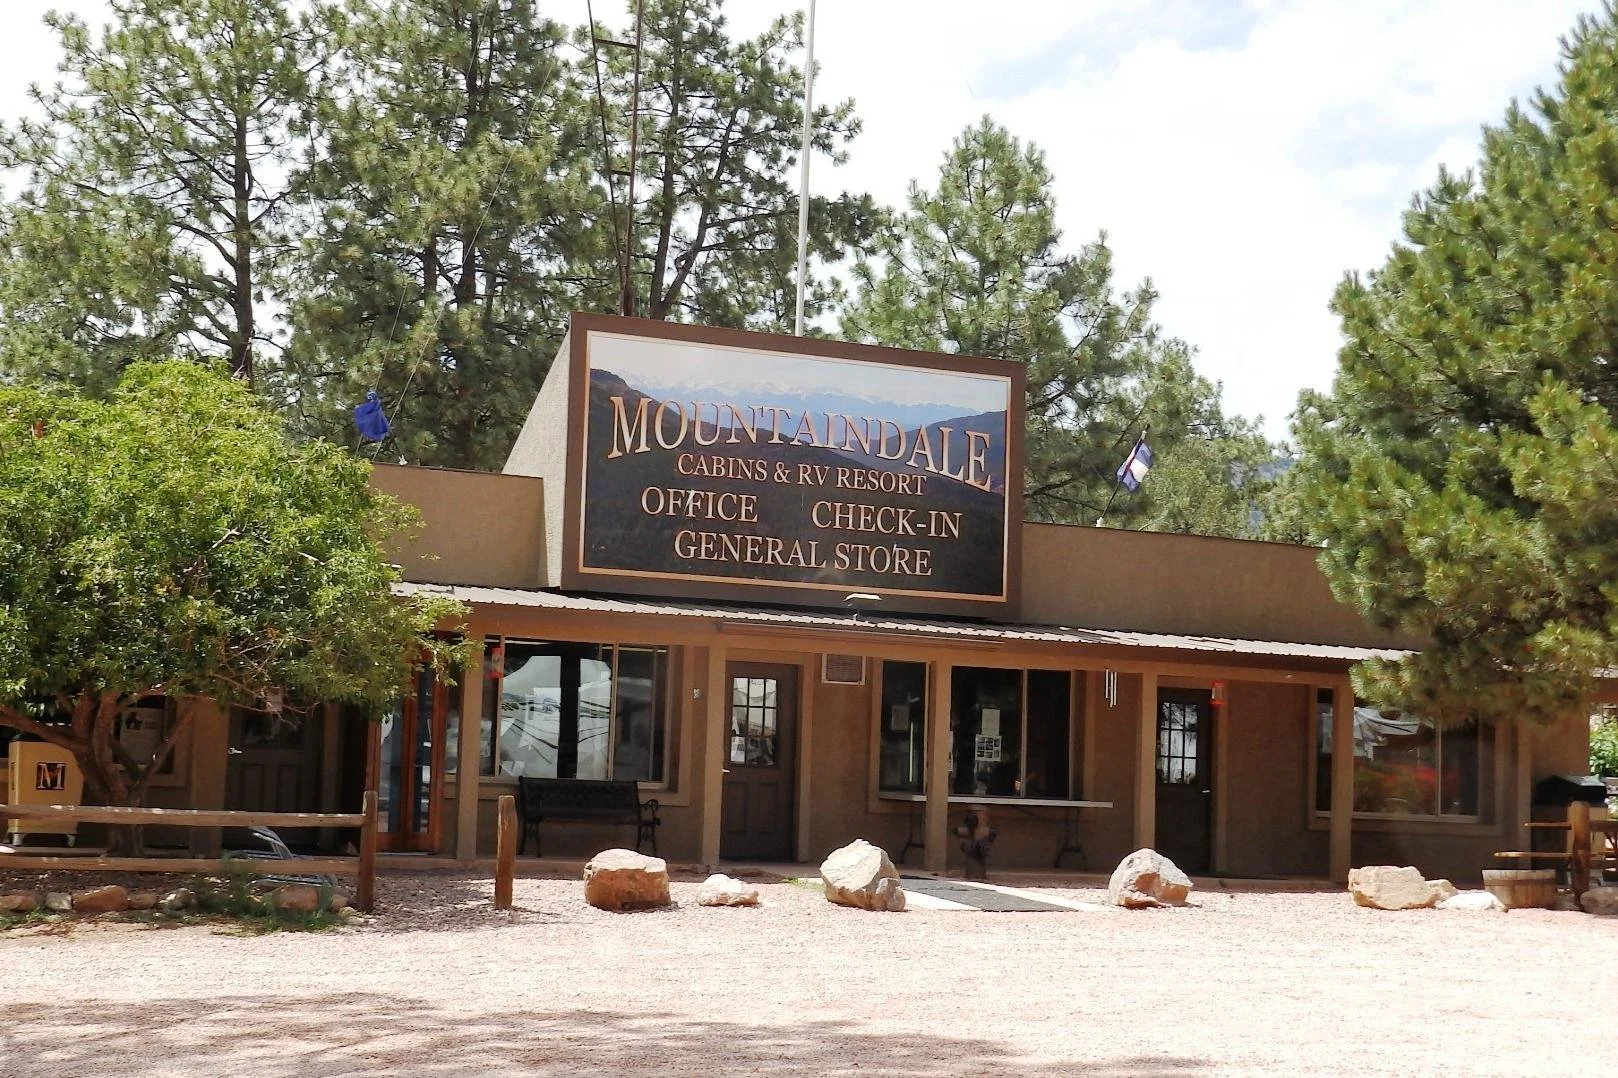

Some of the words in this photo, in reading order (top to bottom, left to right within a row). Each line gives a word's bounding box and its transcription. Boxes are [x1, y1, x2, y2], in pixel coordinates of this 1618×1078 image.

[607, 395, 992, 493] MOUNTAINDALE
[677, 452, 768, 482] CABINS
[773, 465, 790, 484] &
[797, 463, 830, 487] RV
[836, 467, 927, 496] RESORT
[641, 486, 758, 523] OFFICE
[811, 500, 963, 540] CHECK-IN
[674, 530, 827, 569] GENERAL
[834, 542, 932, 576] STORE
[38, 763, 65, 790] M
